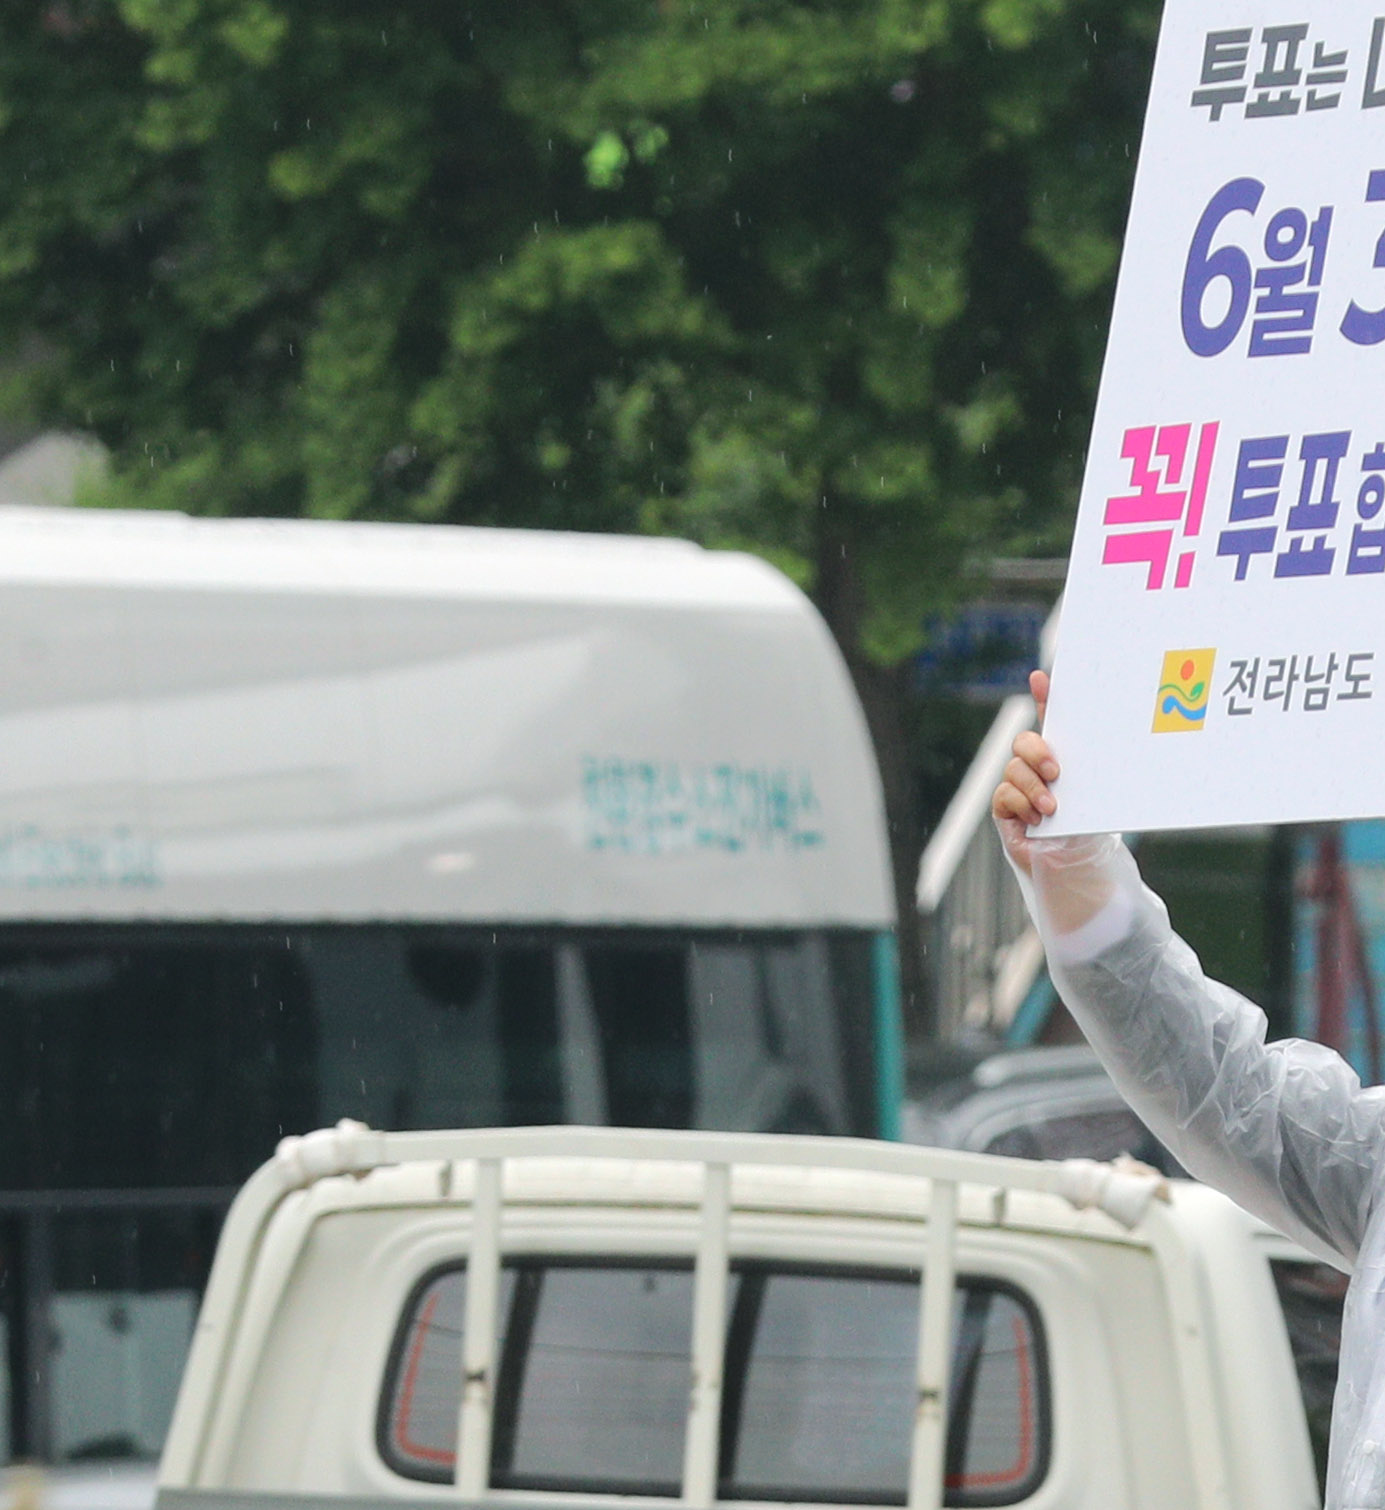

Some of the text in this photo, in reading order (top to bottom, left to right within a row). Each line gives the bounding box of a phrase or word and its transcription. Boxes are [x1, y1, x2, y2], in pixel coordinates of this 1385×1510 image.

[1190, 22, 1349, 122] 투표는
[1180, 176, 1334, 358] 6월
[1102, 420, 1220, 590] 꼭!
[1223, 652, 1374, 715] 전라남도
